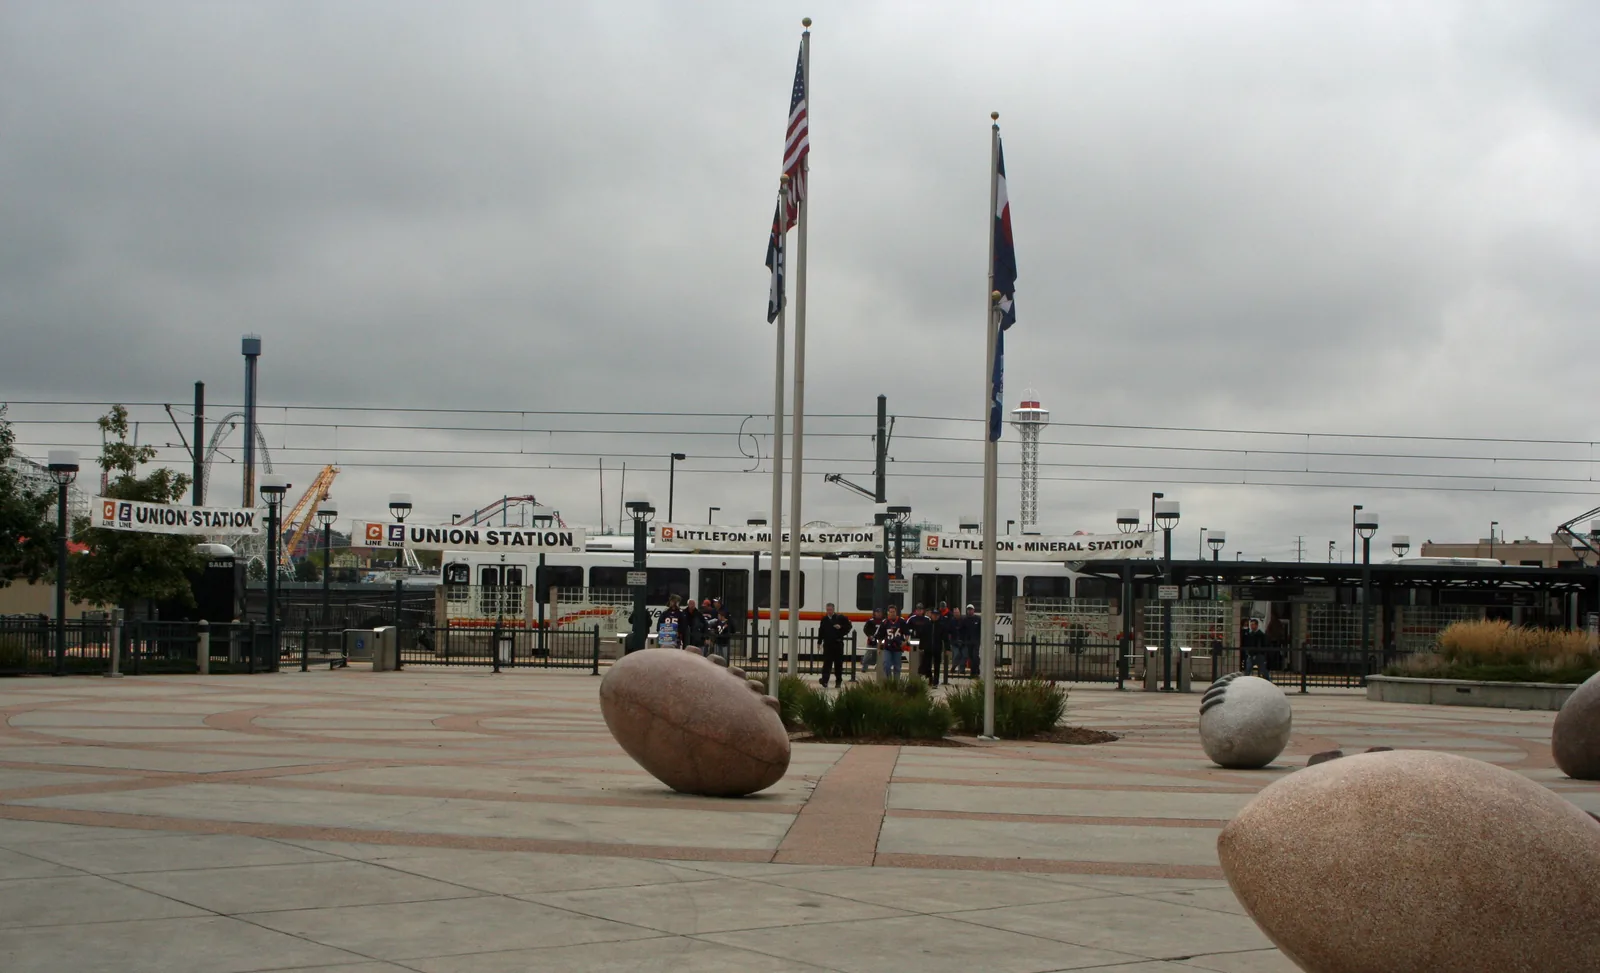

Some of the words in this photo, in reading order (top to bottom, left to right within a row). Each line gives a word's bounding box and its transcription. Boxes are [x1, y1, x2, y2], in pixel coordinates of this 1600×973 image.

[136, 507, 187, 526] UNION
[192, 511, 254, 528] STATION
[411, 527, 479, 544] UNION
[486, 530, 573, 546] STATION
[676, 530, 747, 542] LITTLETON
[757, 533, 815, 543] MIEAL
[819, 532, 874, 543] STATION
[942, 539, 1014, 552] LITTLEON
[1025, 541, 1084, 552] MINERAL
[1088, 539, 1143, 551] STATION
[886, 627, 902, 640] 56
